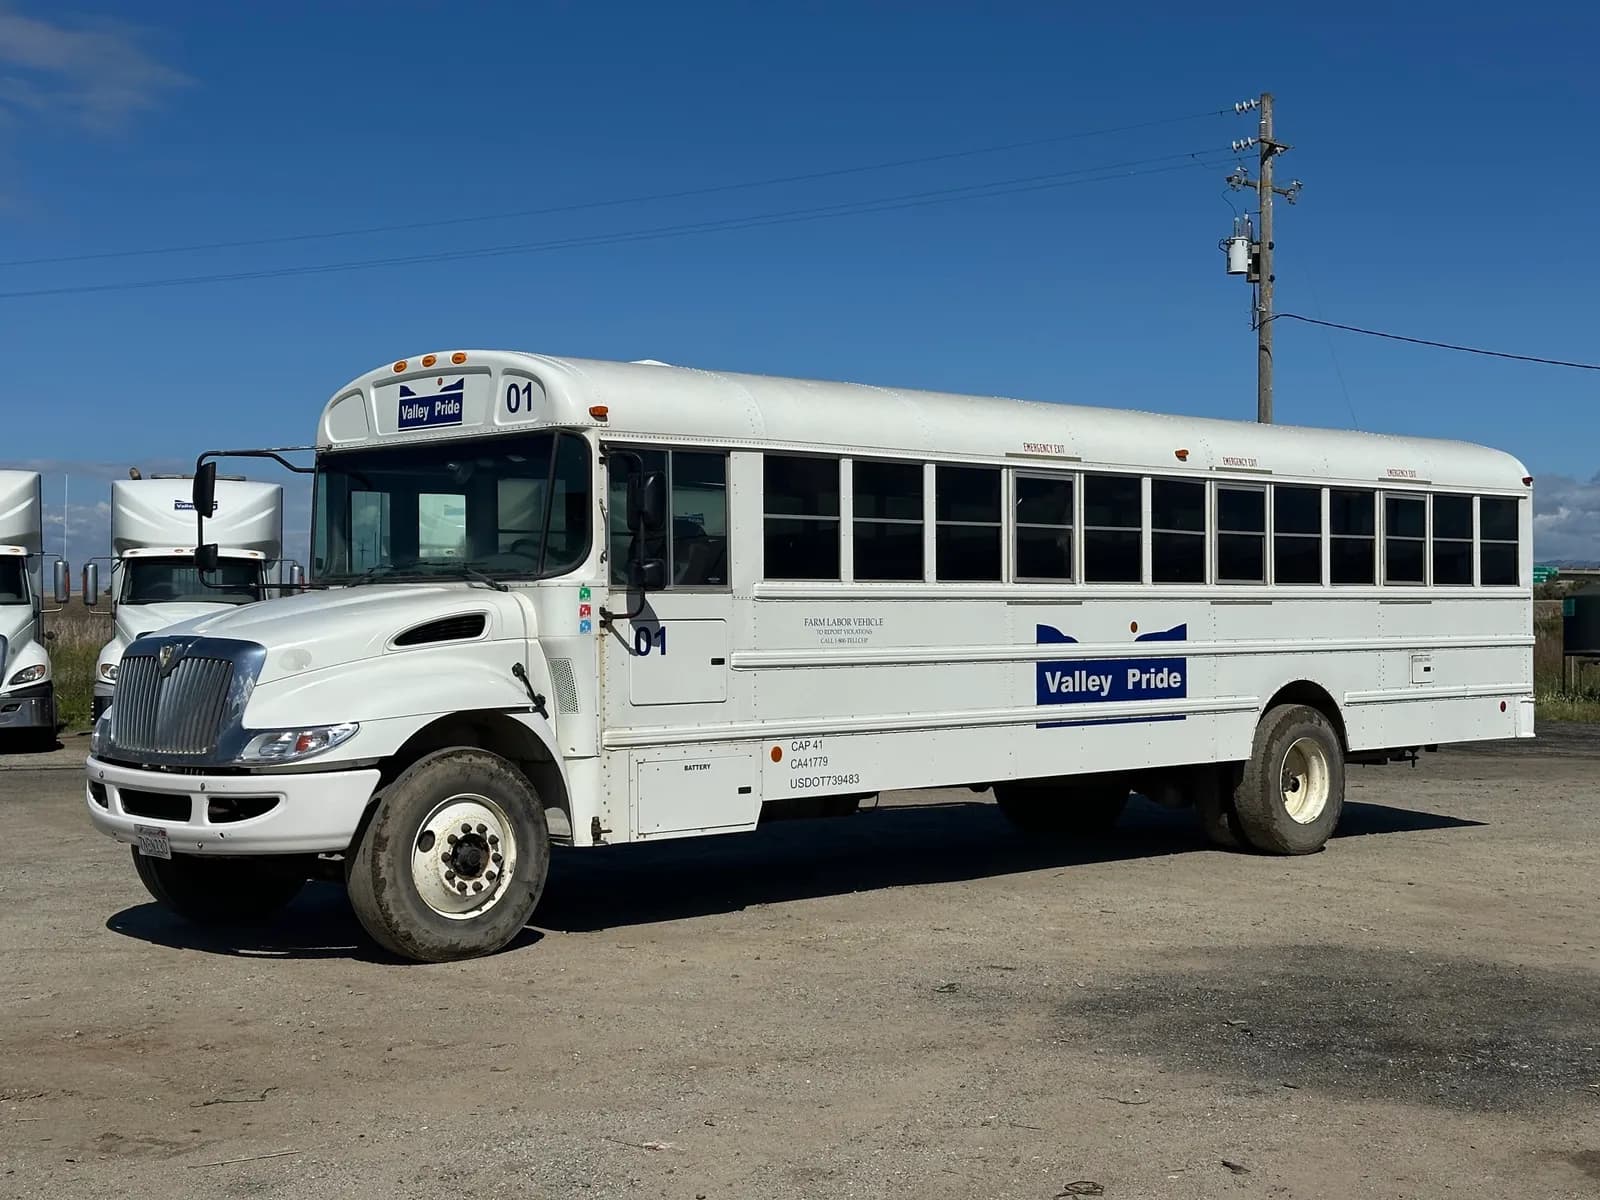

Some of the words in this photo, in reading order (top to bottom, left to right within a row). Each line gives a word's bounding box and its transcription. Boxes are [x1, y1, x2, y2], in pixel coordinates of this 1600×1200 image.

[506, 381, 532, 414] 01
[401, 403, 430, 421] Valley
[434, 400, 460, 416] Pride
[1023, 442, 1053, 453] EMERGENCY
[1054, 444, 1065, 454] EXIT
[1223, 456, 1248, 467] EMERGENCY
[1248, 458, 1258, 468] EXIT
[804, 617, 826, 627] FARM
[827, 617, 852, 627] LABOR
[853, 617, 885, 627] VEHICLE
[634, 626, 666, 656] 01
[1045, 670, 1113, 697] Valley
[1127, 667, 1182, 690] Pride
[791, 740, 811, 752] CAP
[812, 739, 823, 750] 41
[684, 763, 711, 771] BATTERY
[790, 756, 829, 770] CA41779
[790, 773, 860, 789] USDOT739483
